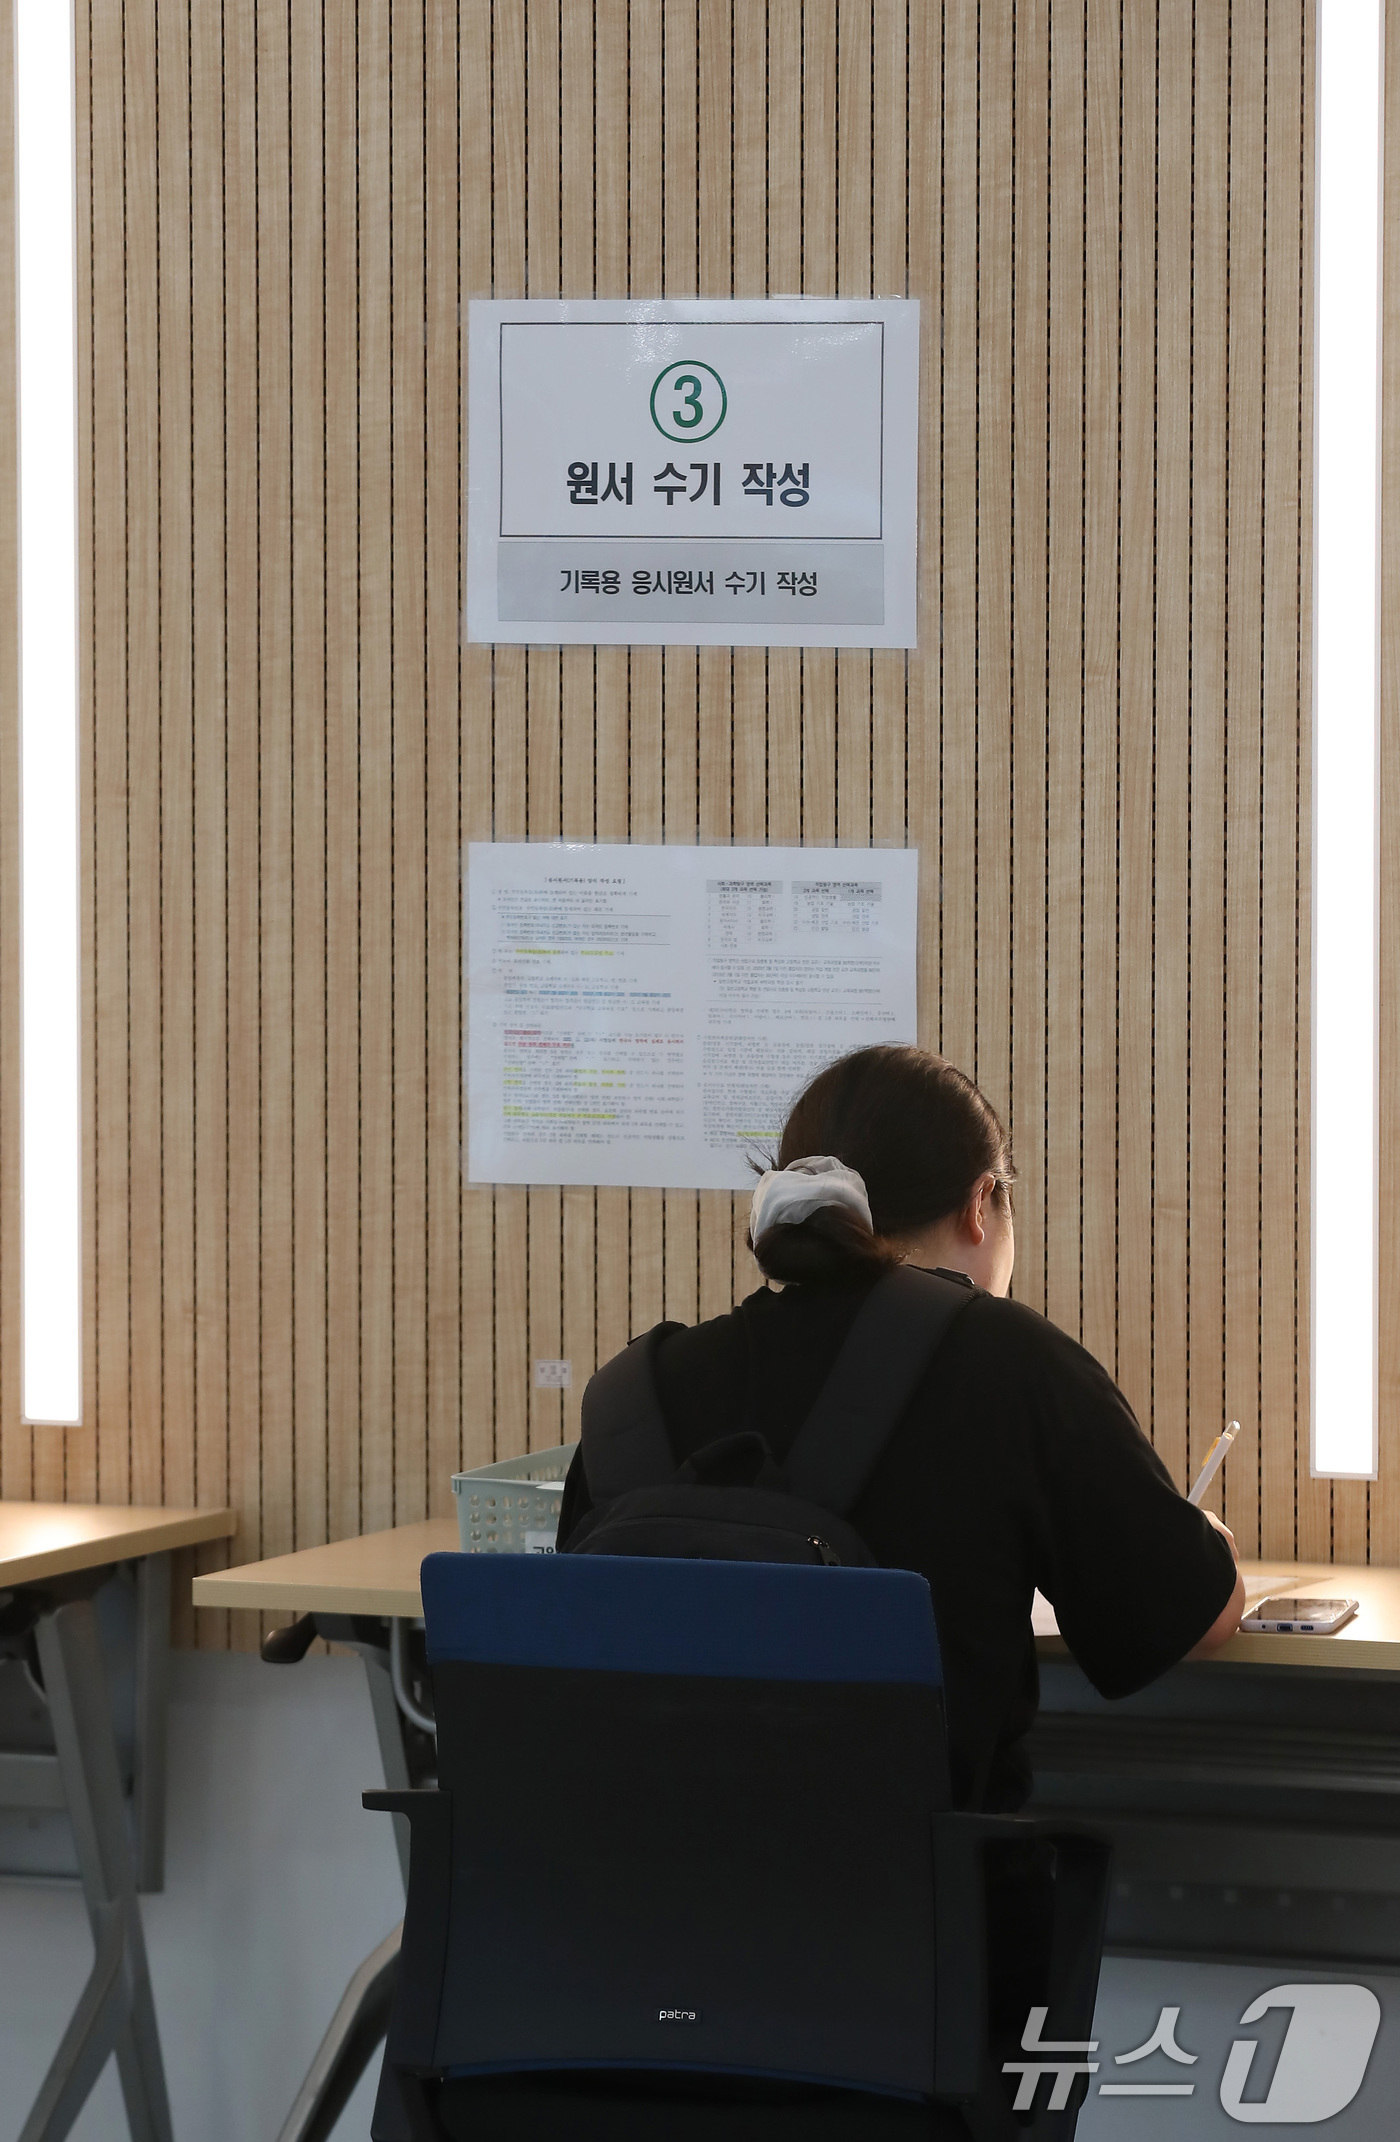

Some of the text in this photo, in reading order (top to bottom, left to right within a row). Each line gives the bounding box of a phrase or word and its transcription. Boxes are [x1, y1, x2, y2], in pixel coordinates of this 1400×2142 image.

[566, 461, 810, 508] 원서 수기 작성
[560, 569, 818, 597] 기록용 응시원서 수기 작성
[659, 2009, 696, 2021] patra
